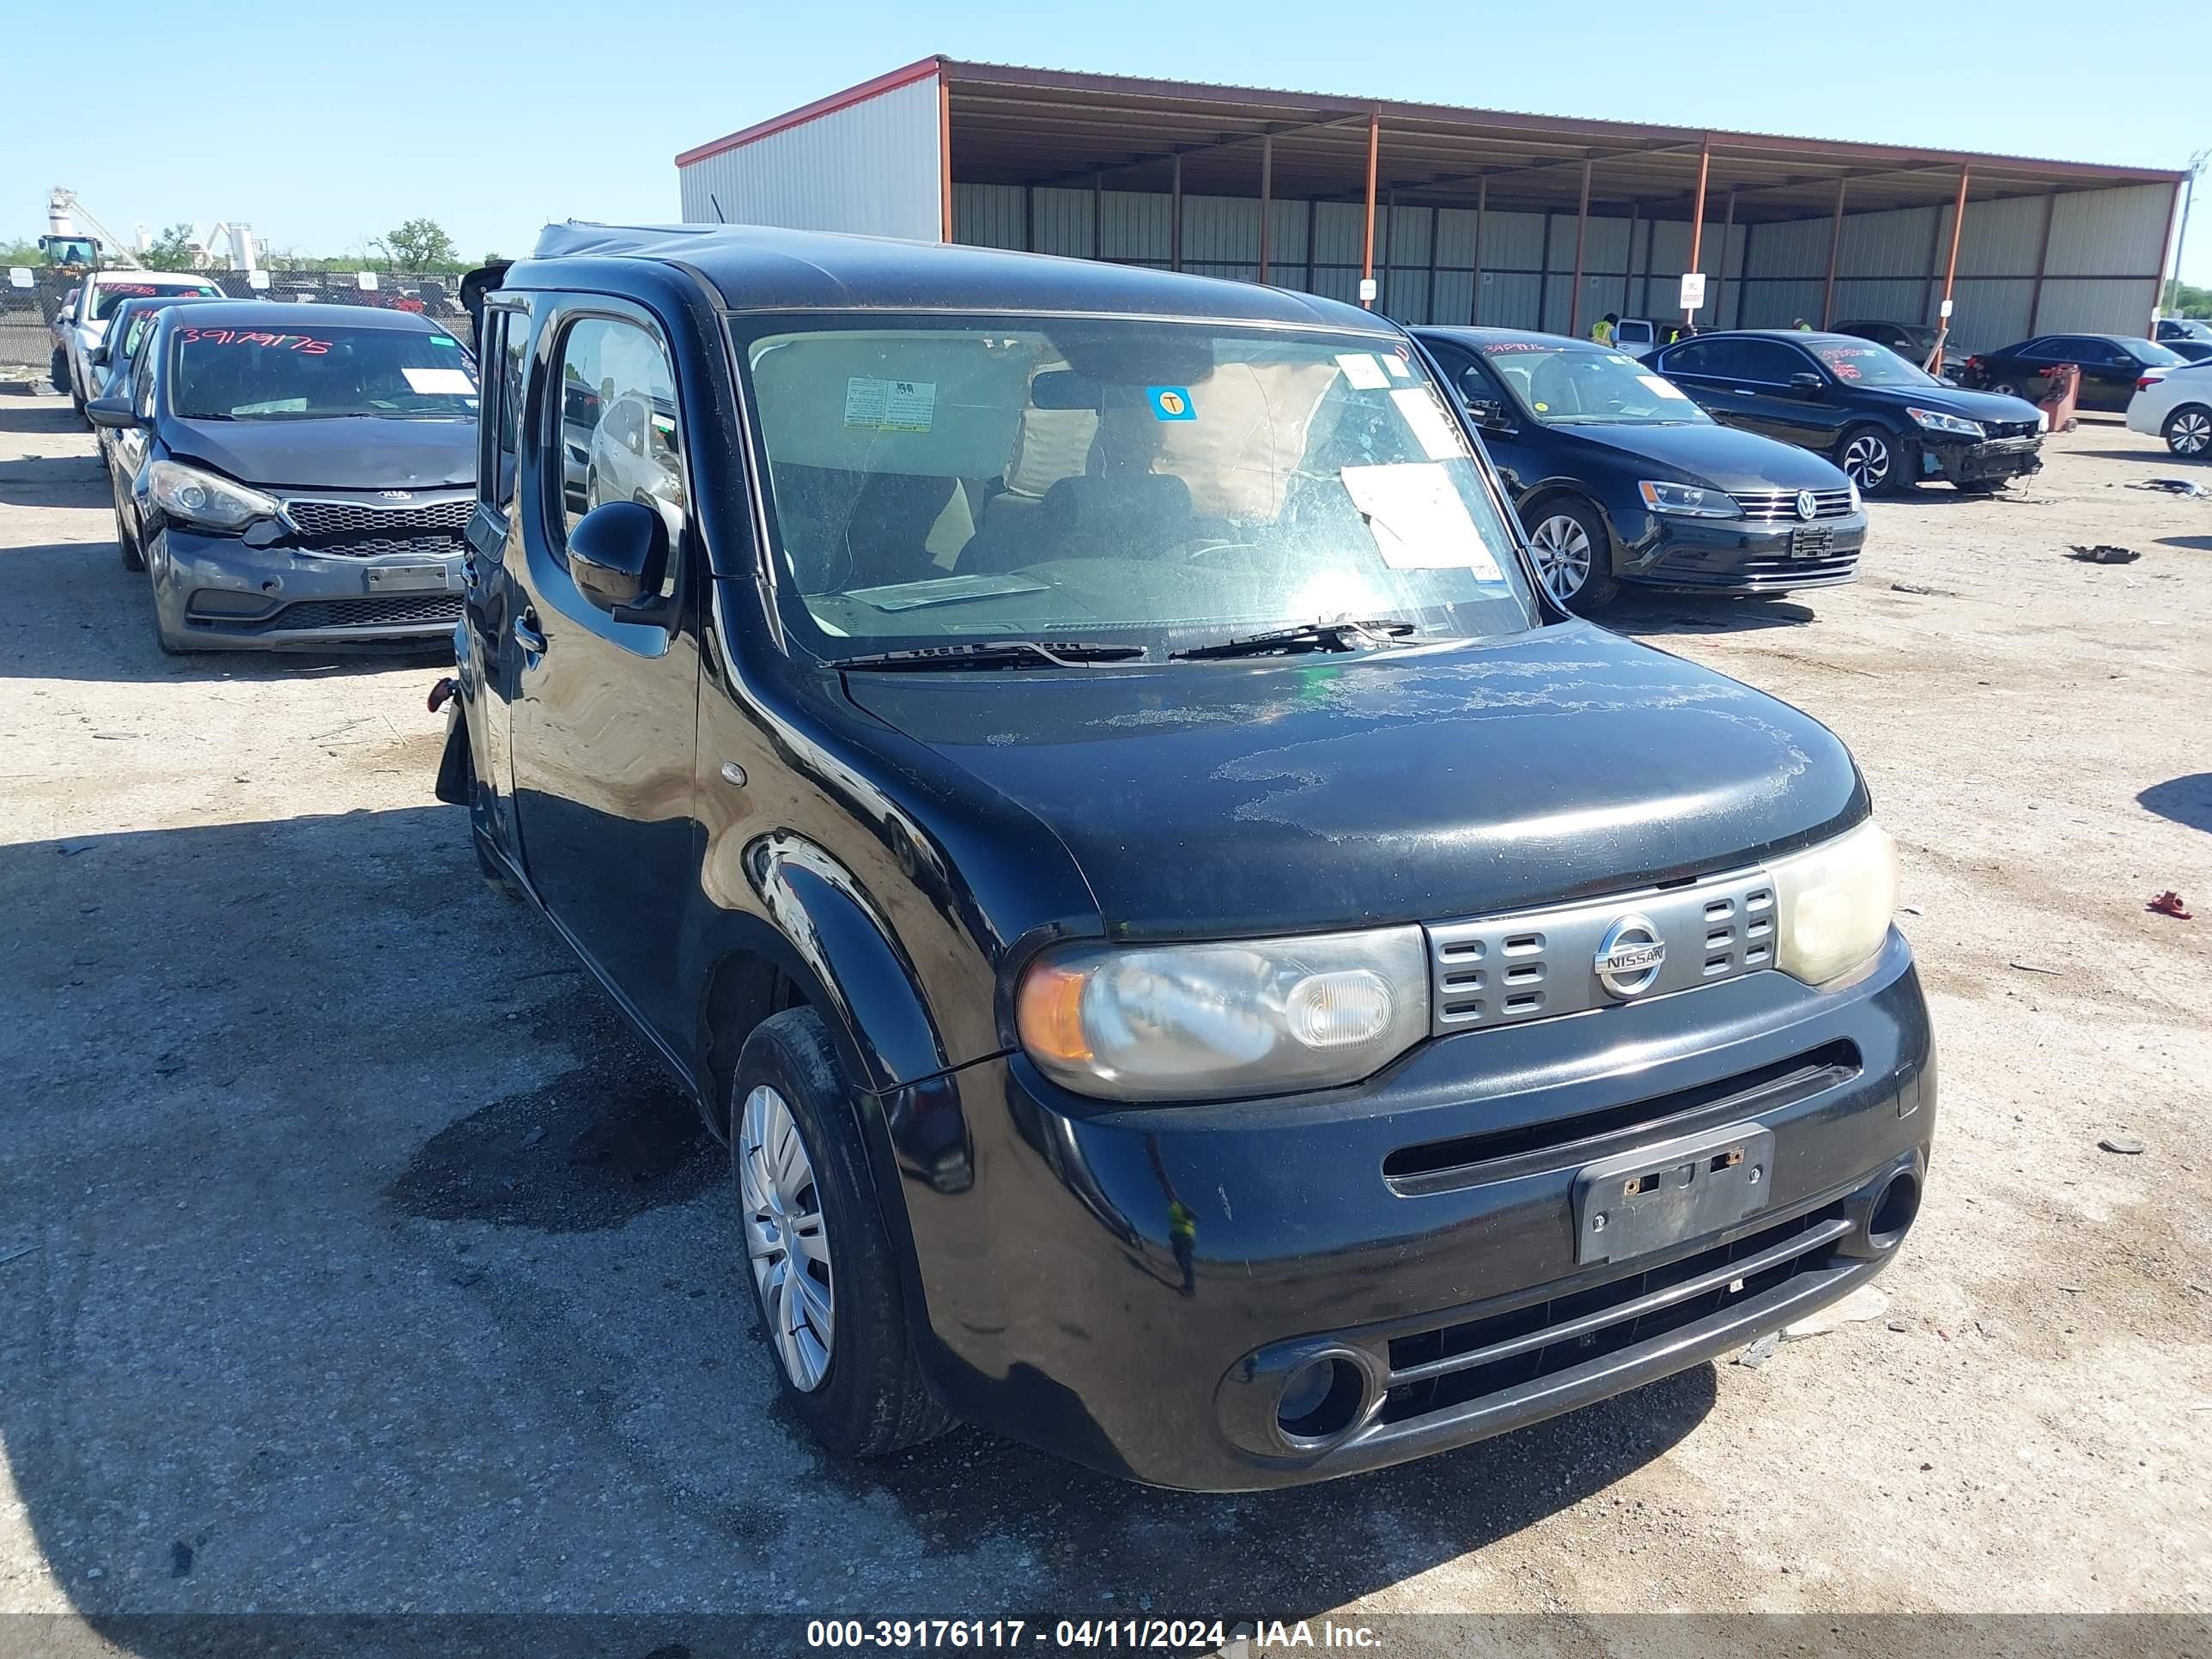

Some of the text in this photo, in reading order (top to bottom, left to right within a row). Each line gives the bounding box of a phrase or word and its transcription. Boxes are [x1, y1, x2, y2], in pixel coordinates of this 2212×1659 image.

[182, 329, 333, 354] 39179175
[1163, 396, 1177, 412] T
[1607, 949, 1662, 969] NISSAN
